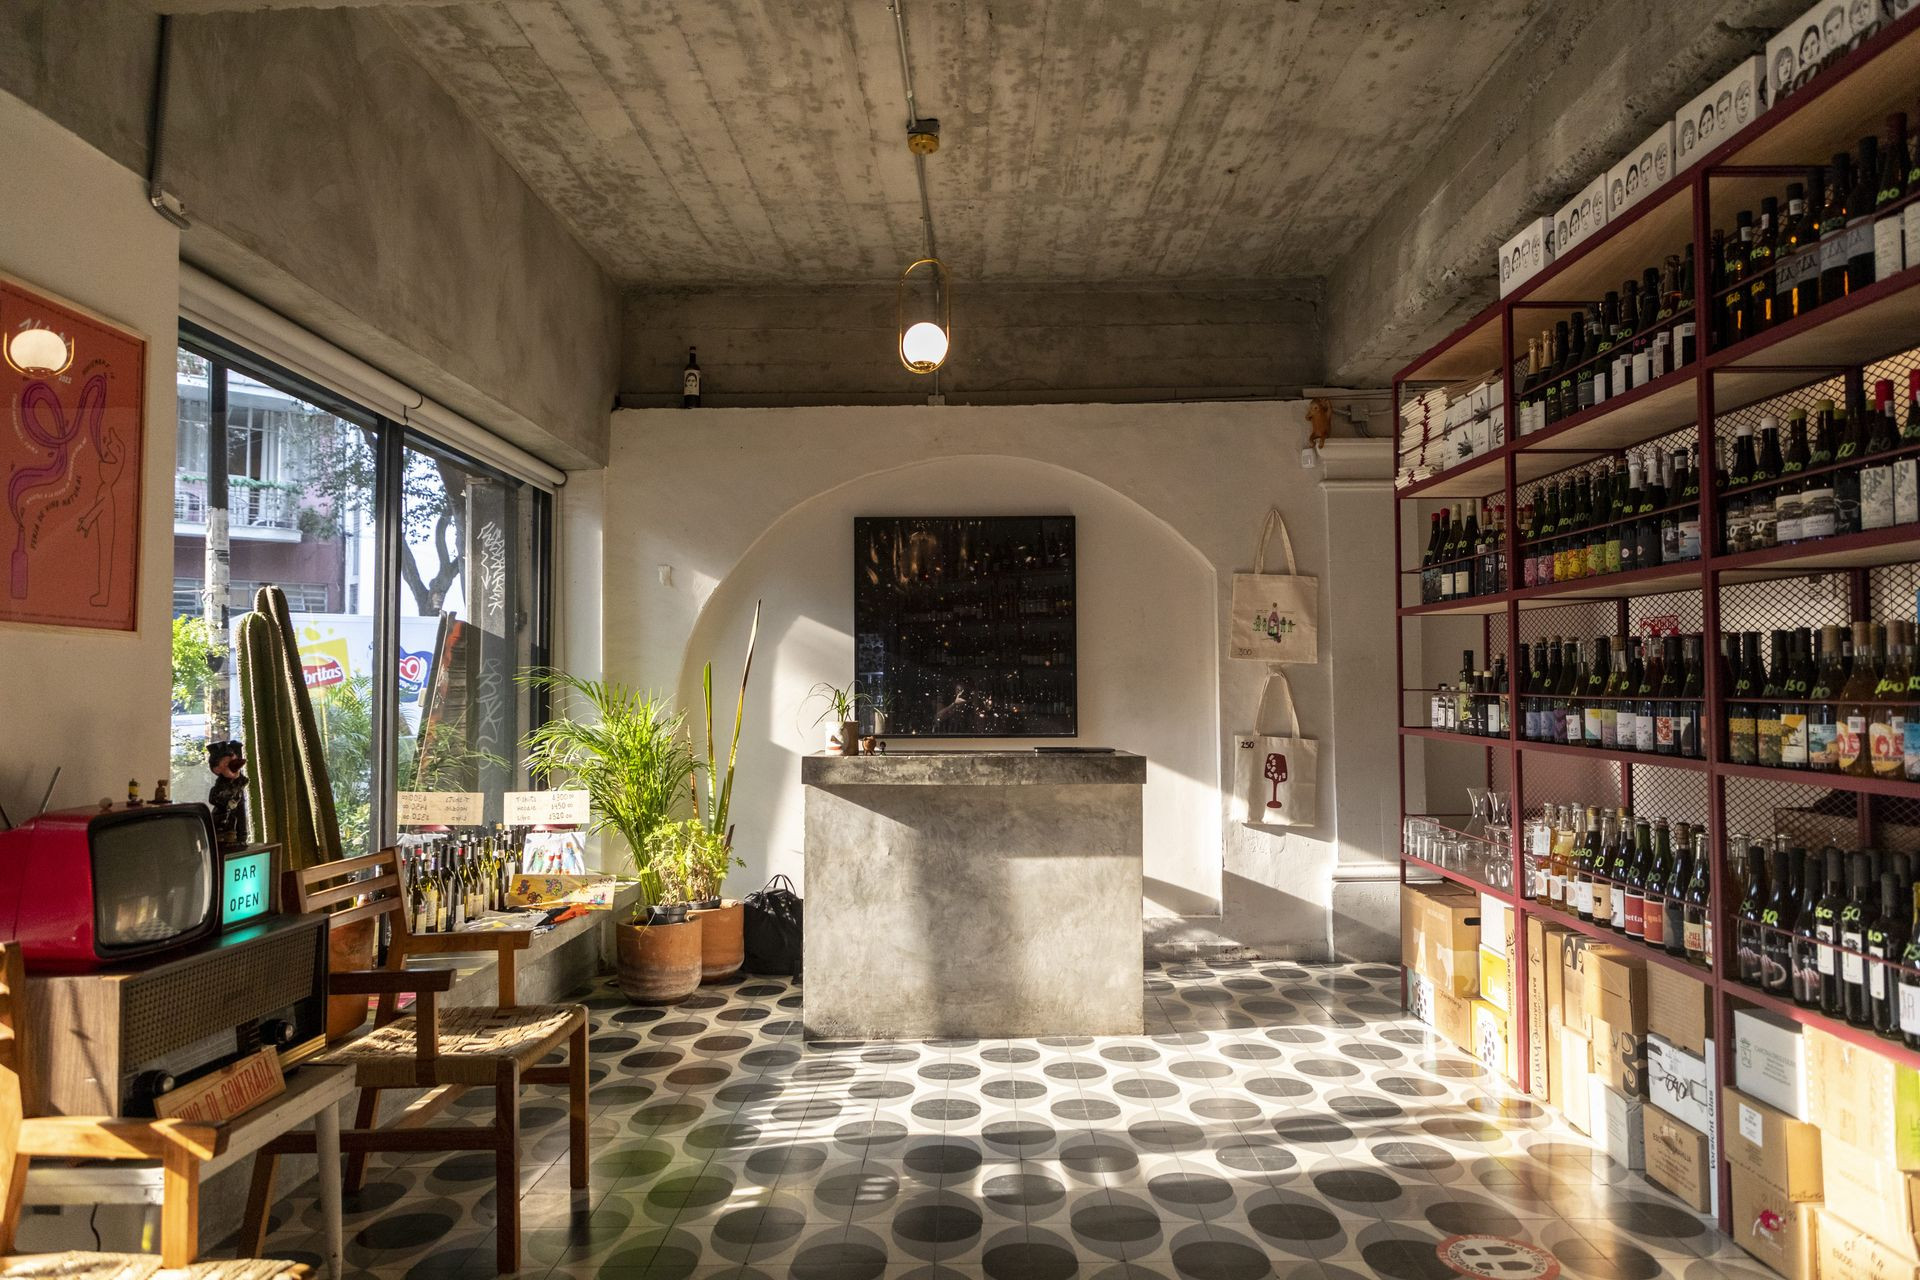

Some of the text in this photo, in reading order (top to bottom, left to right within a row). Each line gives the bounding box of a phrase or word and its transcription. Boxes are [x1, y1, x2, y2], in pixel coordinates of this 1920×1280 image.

[1783, 679, 1805, 692] 150
[1241, 741, 1254, 749] 250
[234, 865, 256, 882] BAR
[230, 892, 259, 912] OPEN
[220, 1056, 277, 1114] CONTRADA
